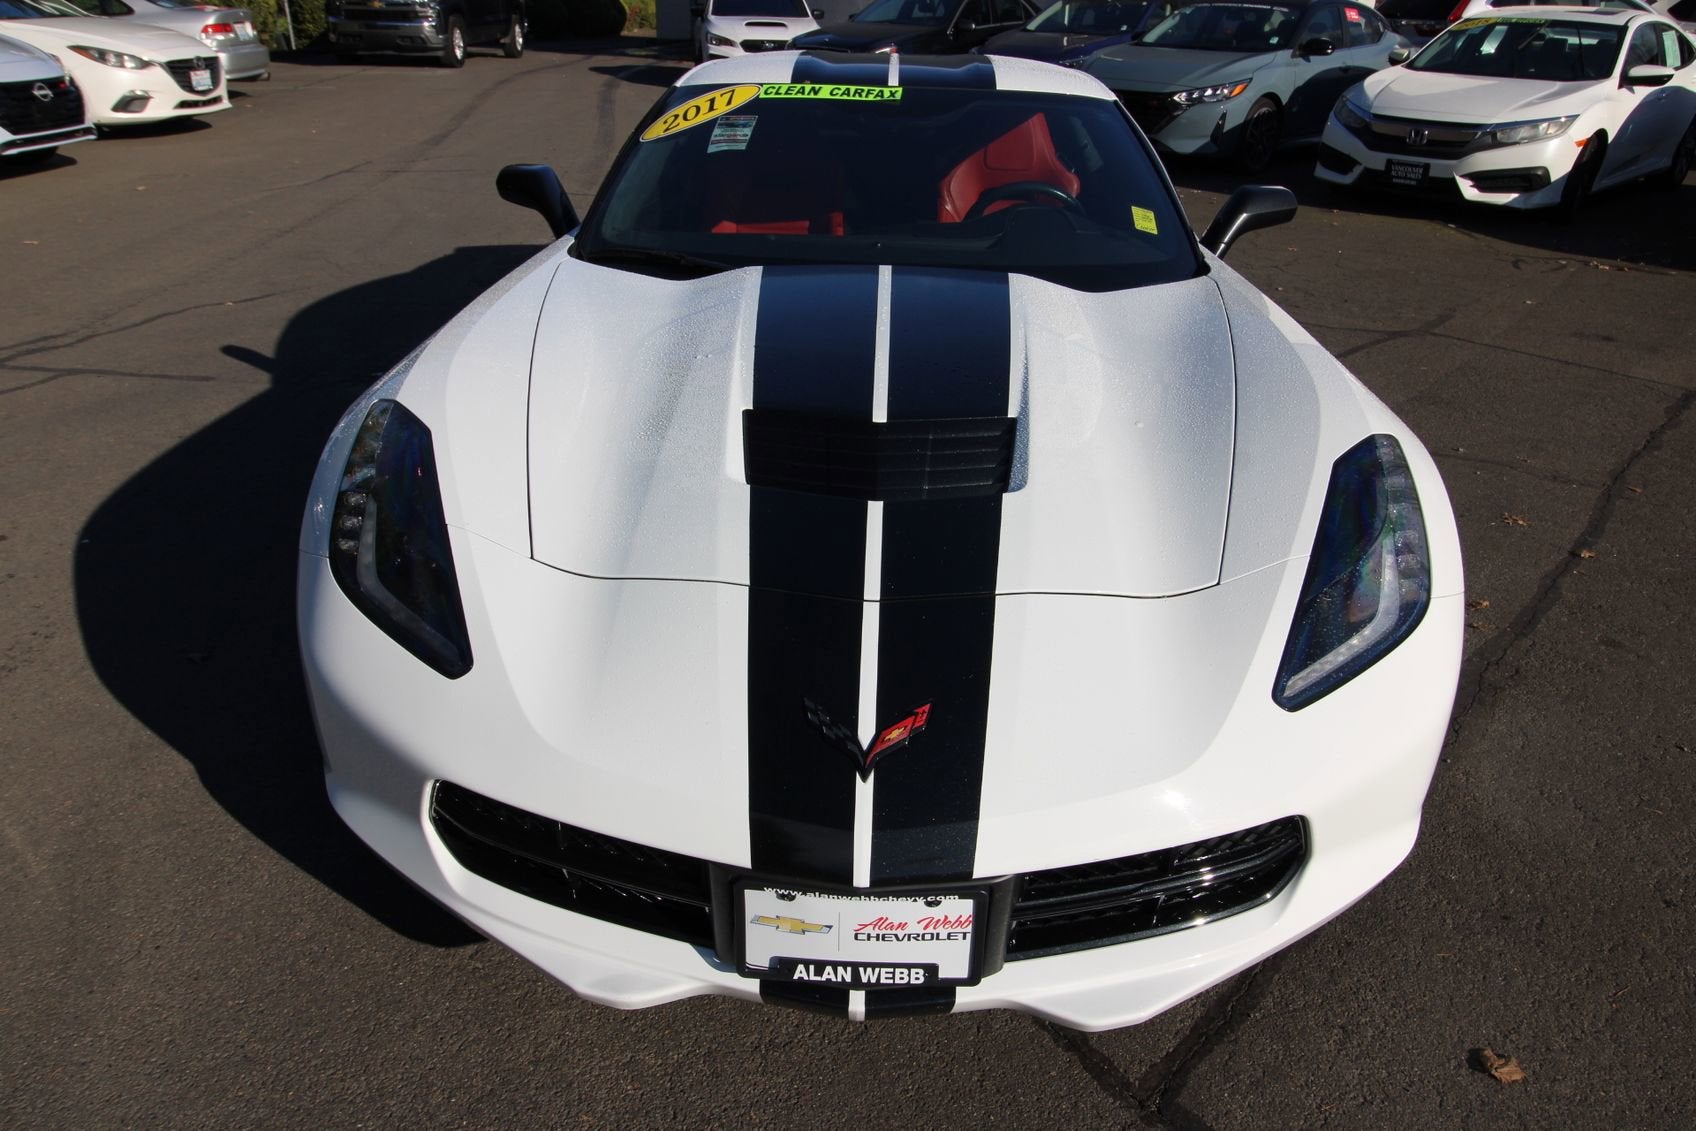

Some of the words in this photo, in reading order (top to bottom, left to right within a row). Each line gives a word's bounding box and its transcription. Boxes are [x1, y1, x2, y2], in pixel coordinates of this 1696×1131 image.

[763, 85, 822, 97] CLEAN
[829, 87, 900, 100] CARFAX
[662, 89, 737, 133] 2017
[853, 916, 909, 932] Alan
[917, 914, 973, 931] Webb
[853, 931, 971, 942] CHEVROLET
[793, 964, 852, 982] ALAN
[859, 966, 925, 984] WEBB
